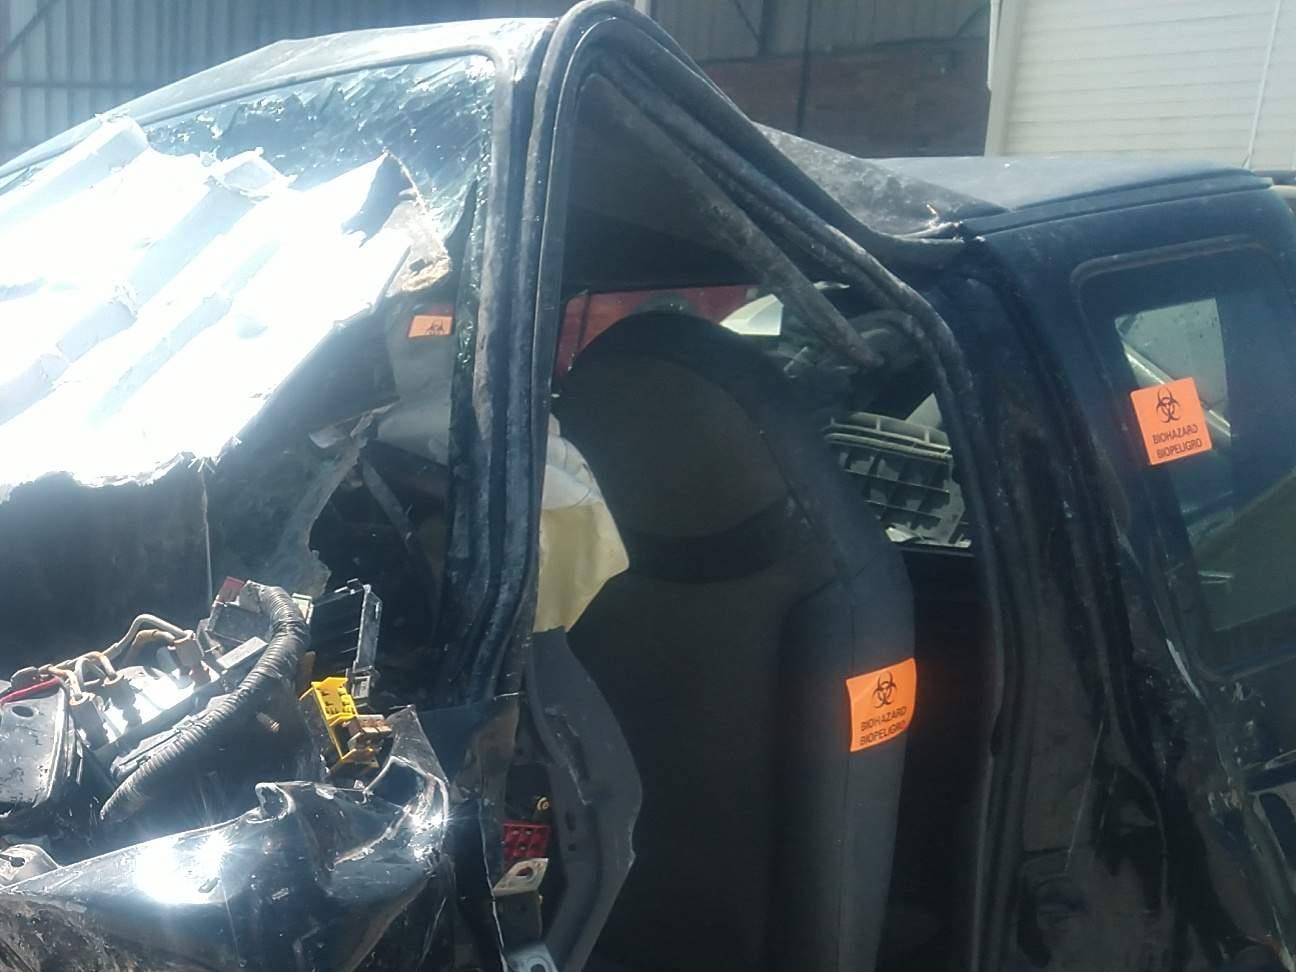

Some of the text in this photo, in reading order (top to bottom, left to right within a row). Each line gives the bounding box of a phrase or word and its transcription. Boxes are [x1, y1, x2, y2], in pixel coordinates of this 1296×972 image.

[1152, 423, 1199, 445] BIOHAZARD
[1156, 438, 1203, 458] BIOPELIGRO
[860, 706, 907, 732] BIOHAZARD
